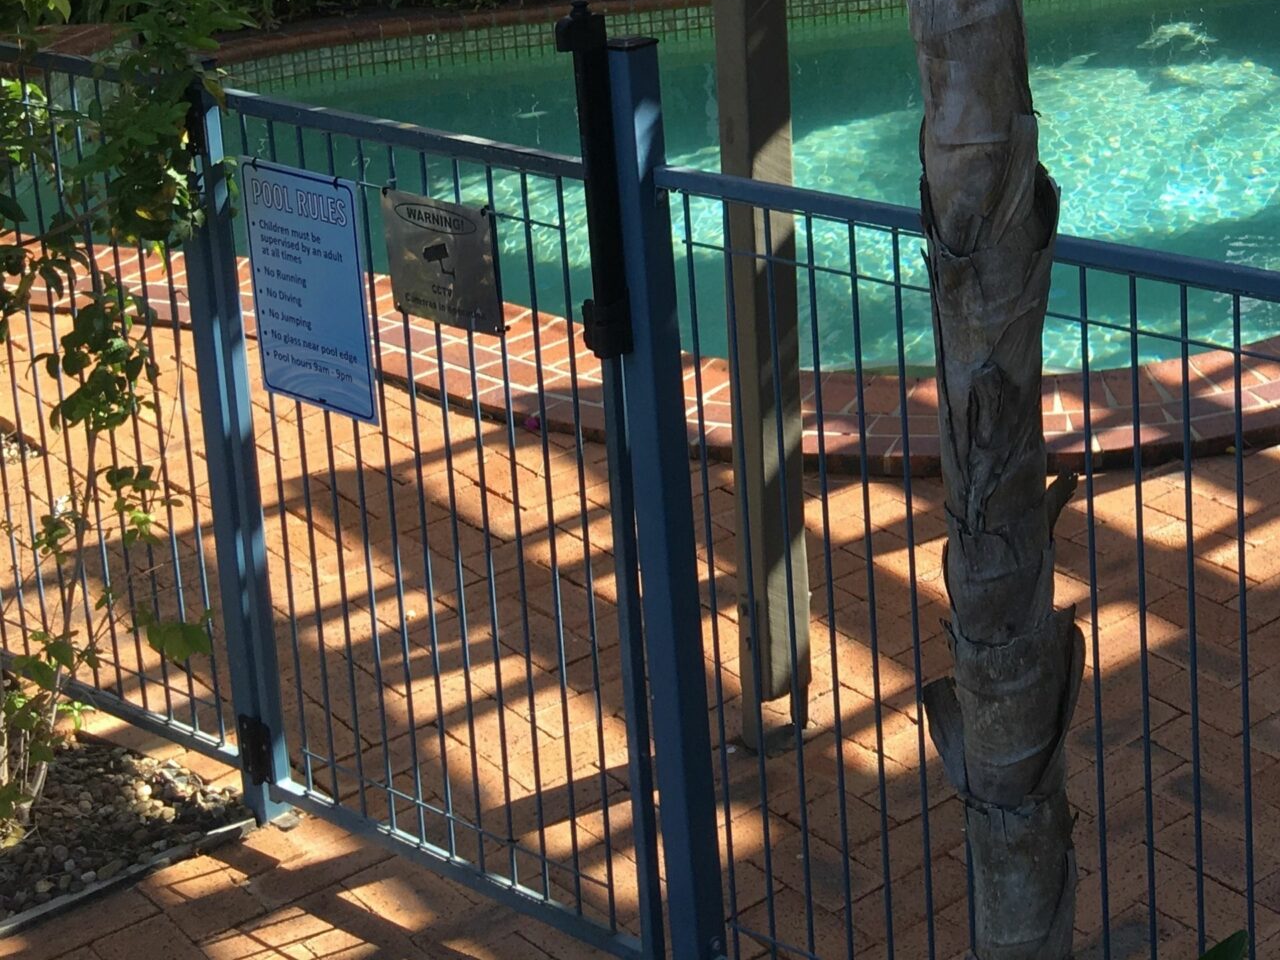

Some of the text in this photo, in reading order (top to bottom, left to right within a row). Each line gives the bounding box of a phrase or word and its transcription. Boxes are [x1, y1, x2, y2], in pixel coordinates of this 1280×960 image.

[252, 178, 348, 227] POOL RULES
[406, 207, 464, 231] WARNING!
[259, 219, 321, 244] Children must be
[260, 234, 343, 263] supervised by an adult
[262, 247, 302, 264] at all times
[264, 266, 307, 289] No Running
[266, 287, 302, 308] No Diving
[269, 308, 312, 331] No Jumping
[271, 329, 358, 364] No glass near pool edge
[273, 350, 290, 363] Pool
[291, 354, 312, 370] hours
[313, 361, 330, 375] 9am
[336, 368, 353, 383] 9pm
